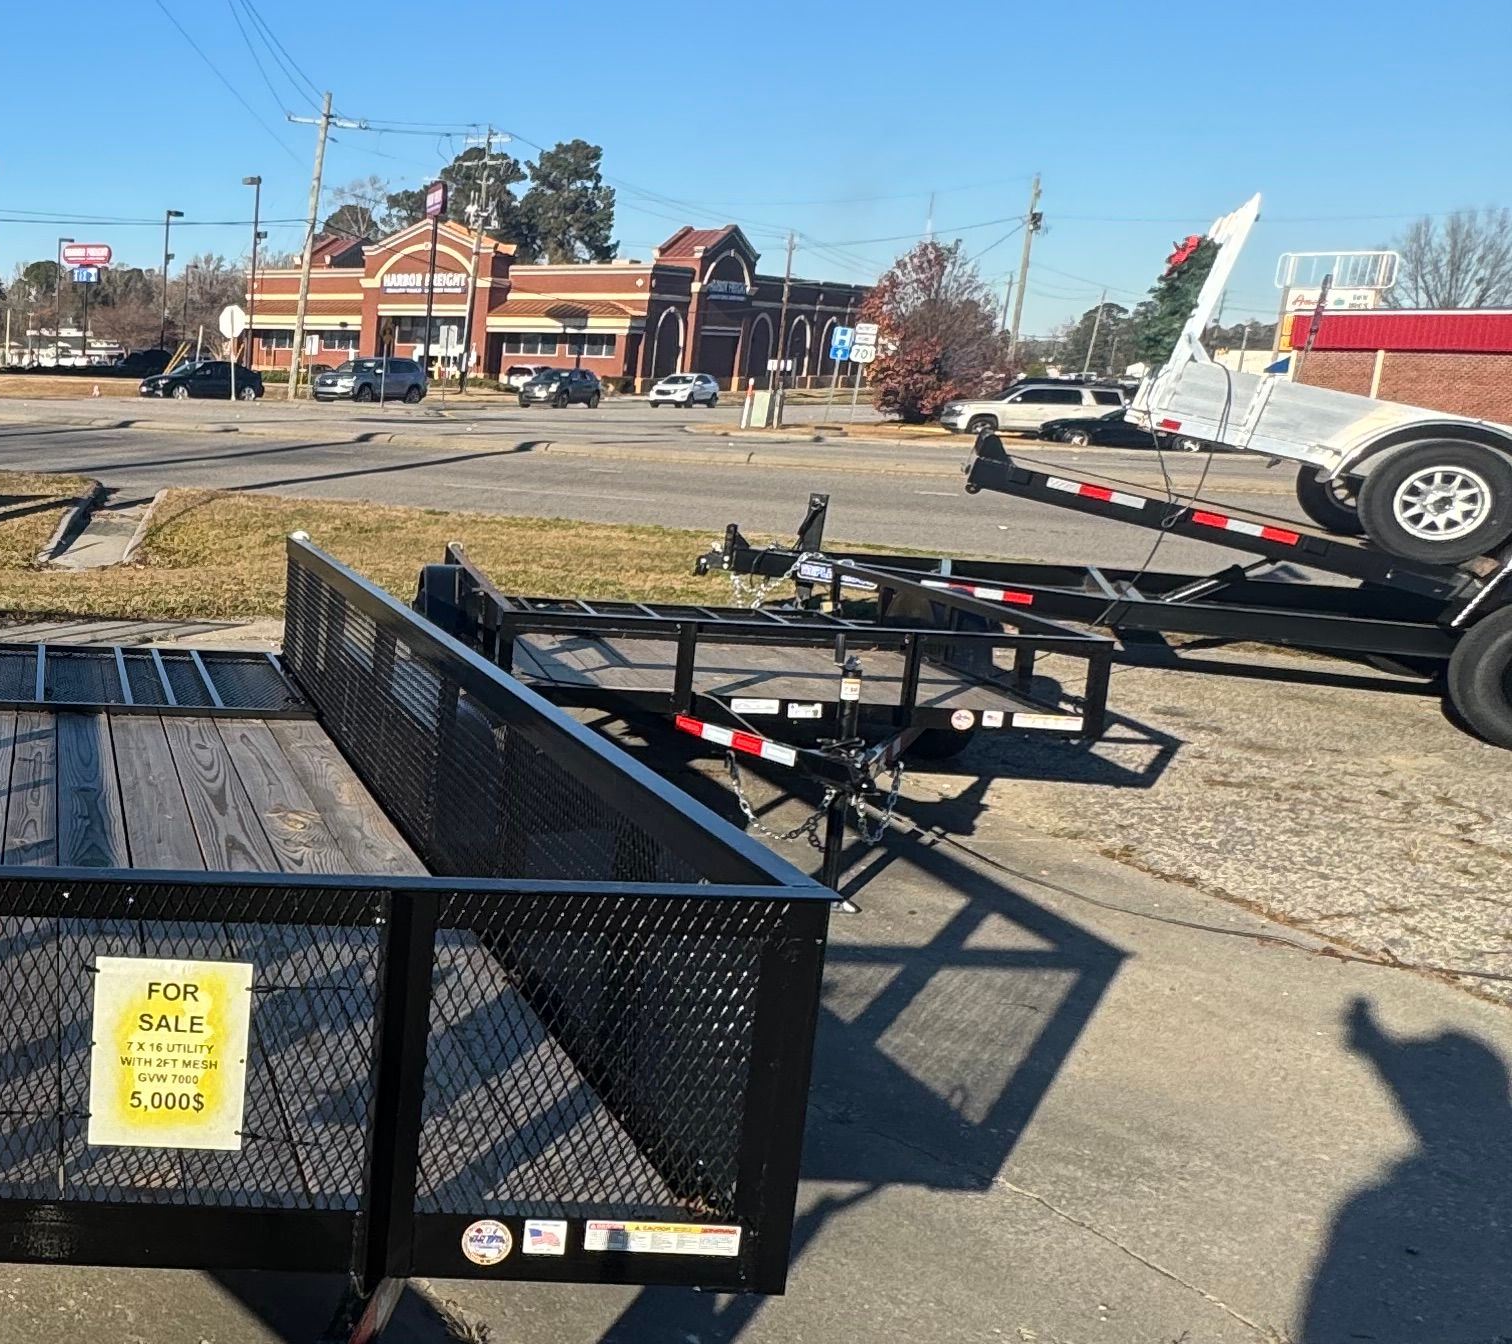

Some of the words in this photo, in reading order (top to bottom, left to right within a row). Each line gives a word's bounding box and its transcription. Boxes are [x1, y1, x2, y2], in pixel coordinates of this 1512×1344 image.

[854, 348, 873, 359] 701
[147, 982, 199, 1002] FOR
[138, 1013, 204, 1034] SALE
[126, 1041, 133, 1051] 7
[136, 1041, 146, 1052] X
[149, 1042, 163, 1053] 16
[166, 1042, 214, 1055] UTILITY
[120, 1056, 152, 1067] WITH
[156, 1058, 179, 1068] 2FT
[182, 1058, 218, 1070] MESH
[138, 1072, 168, 1084] GVW
[171, 1074, 199, 1085] 7000
[129, 1091, 205, 1113] 5,000$
